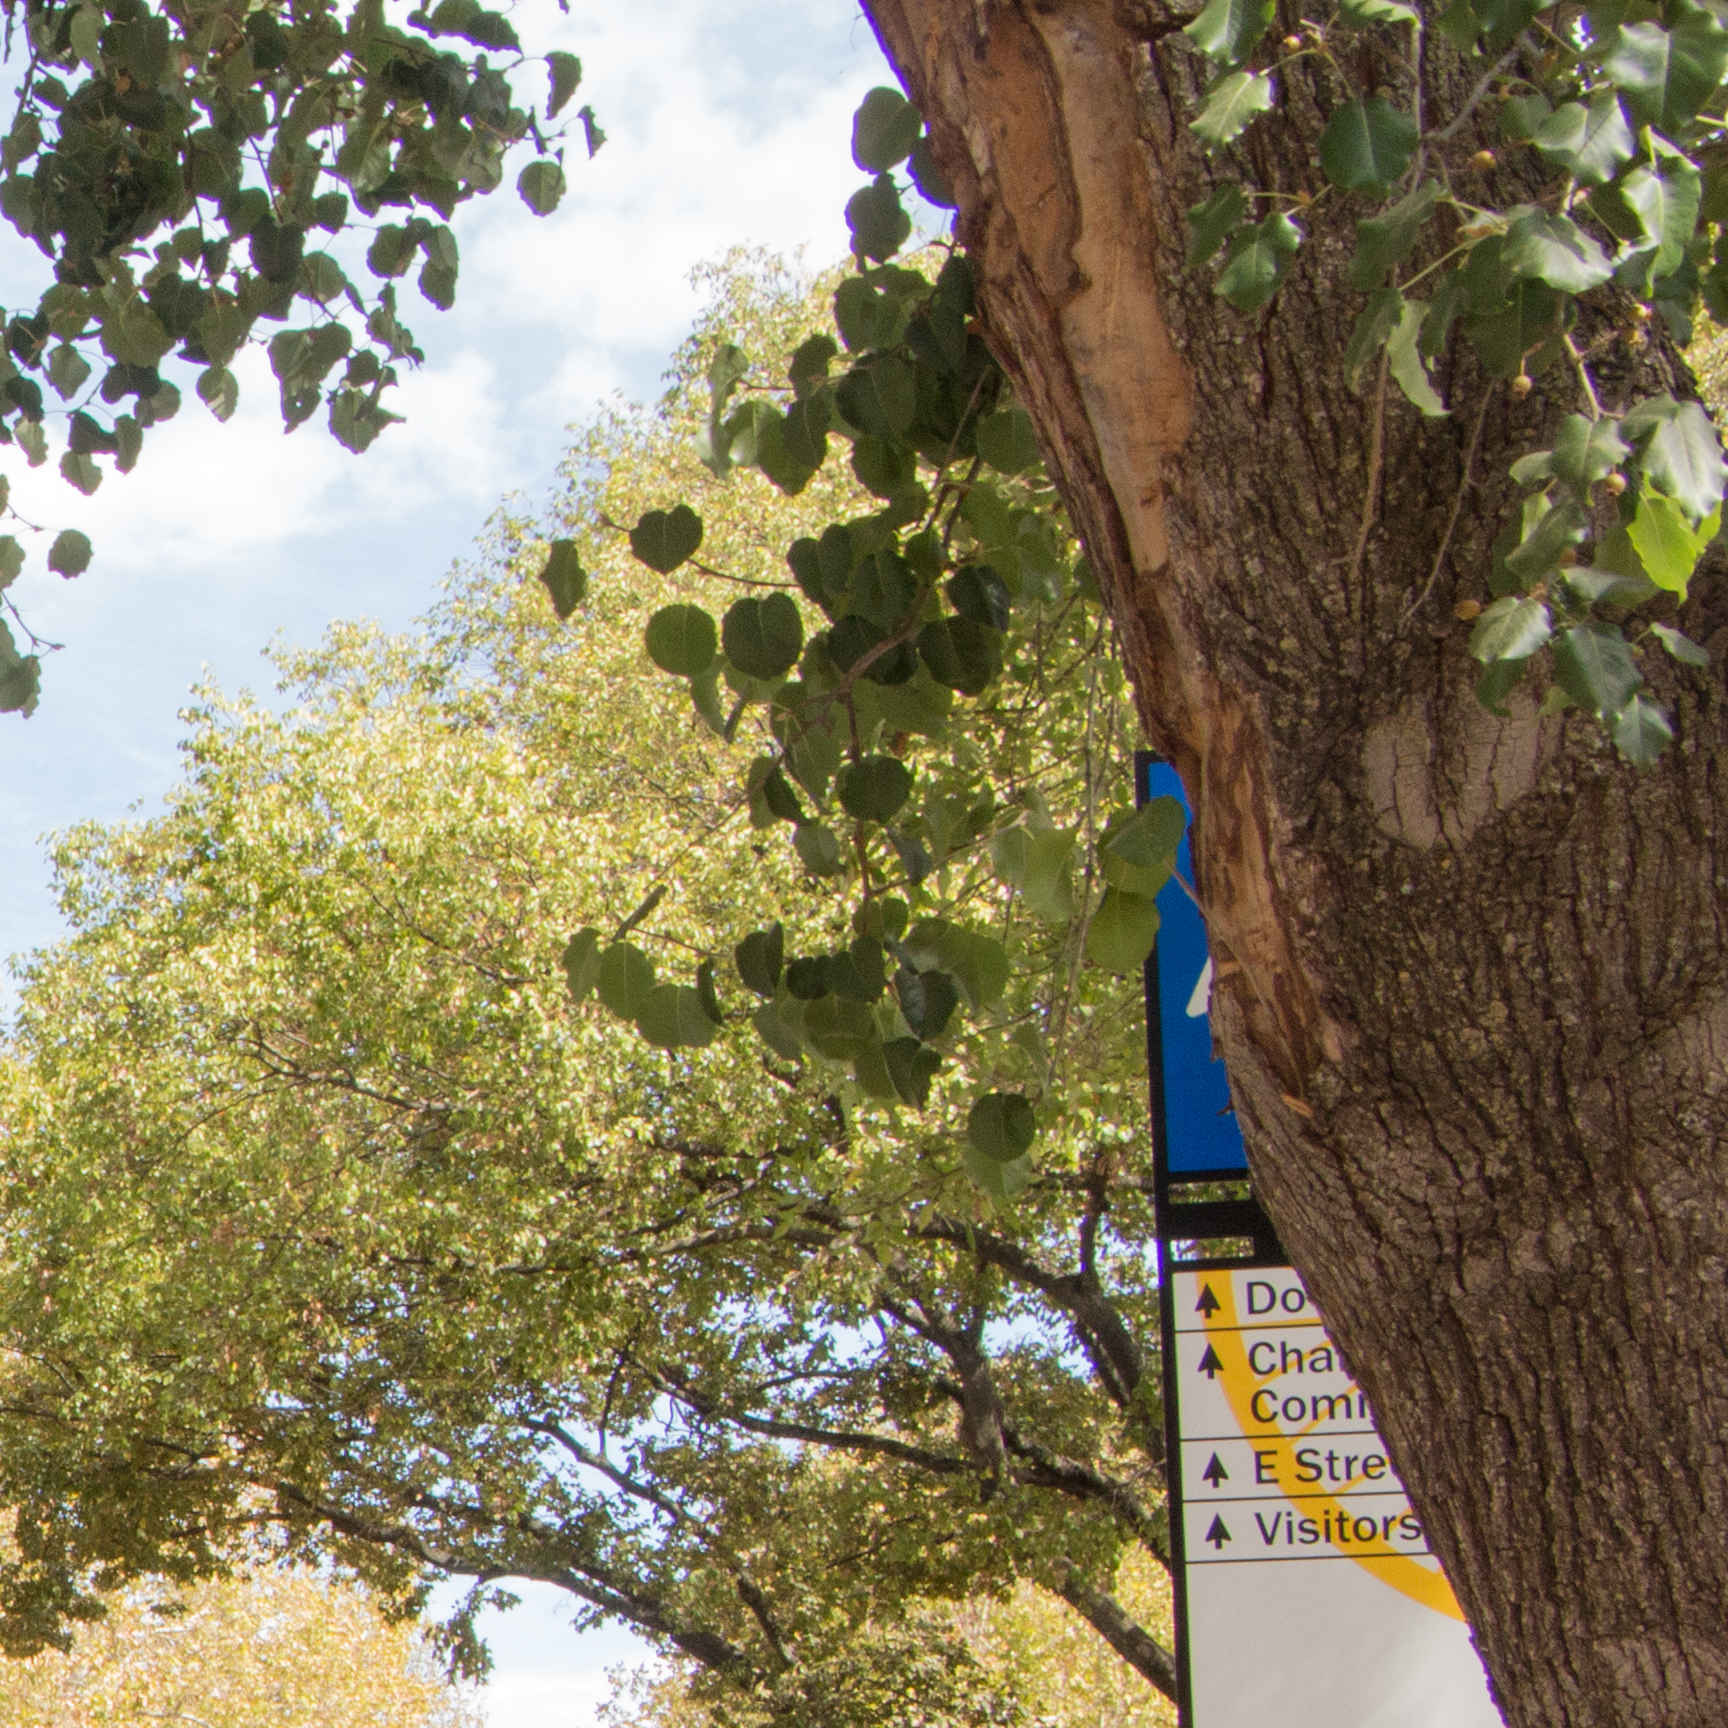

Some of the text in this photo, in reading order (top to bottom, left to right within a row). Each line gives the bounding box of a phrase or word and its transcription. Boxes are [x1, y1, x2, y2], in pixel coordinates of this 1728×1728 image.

[1246, 1280, 1306, 1315] Do
[1248, 1341, 1344, 1375] Cha
[1254, 1447, 1387, 1484] E Stre
[1254, 1508, 1423, 1546] Visitors
